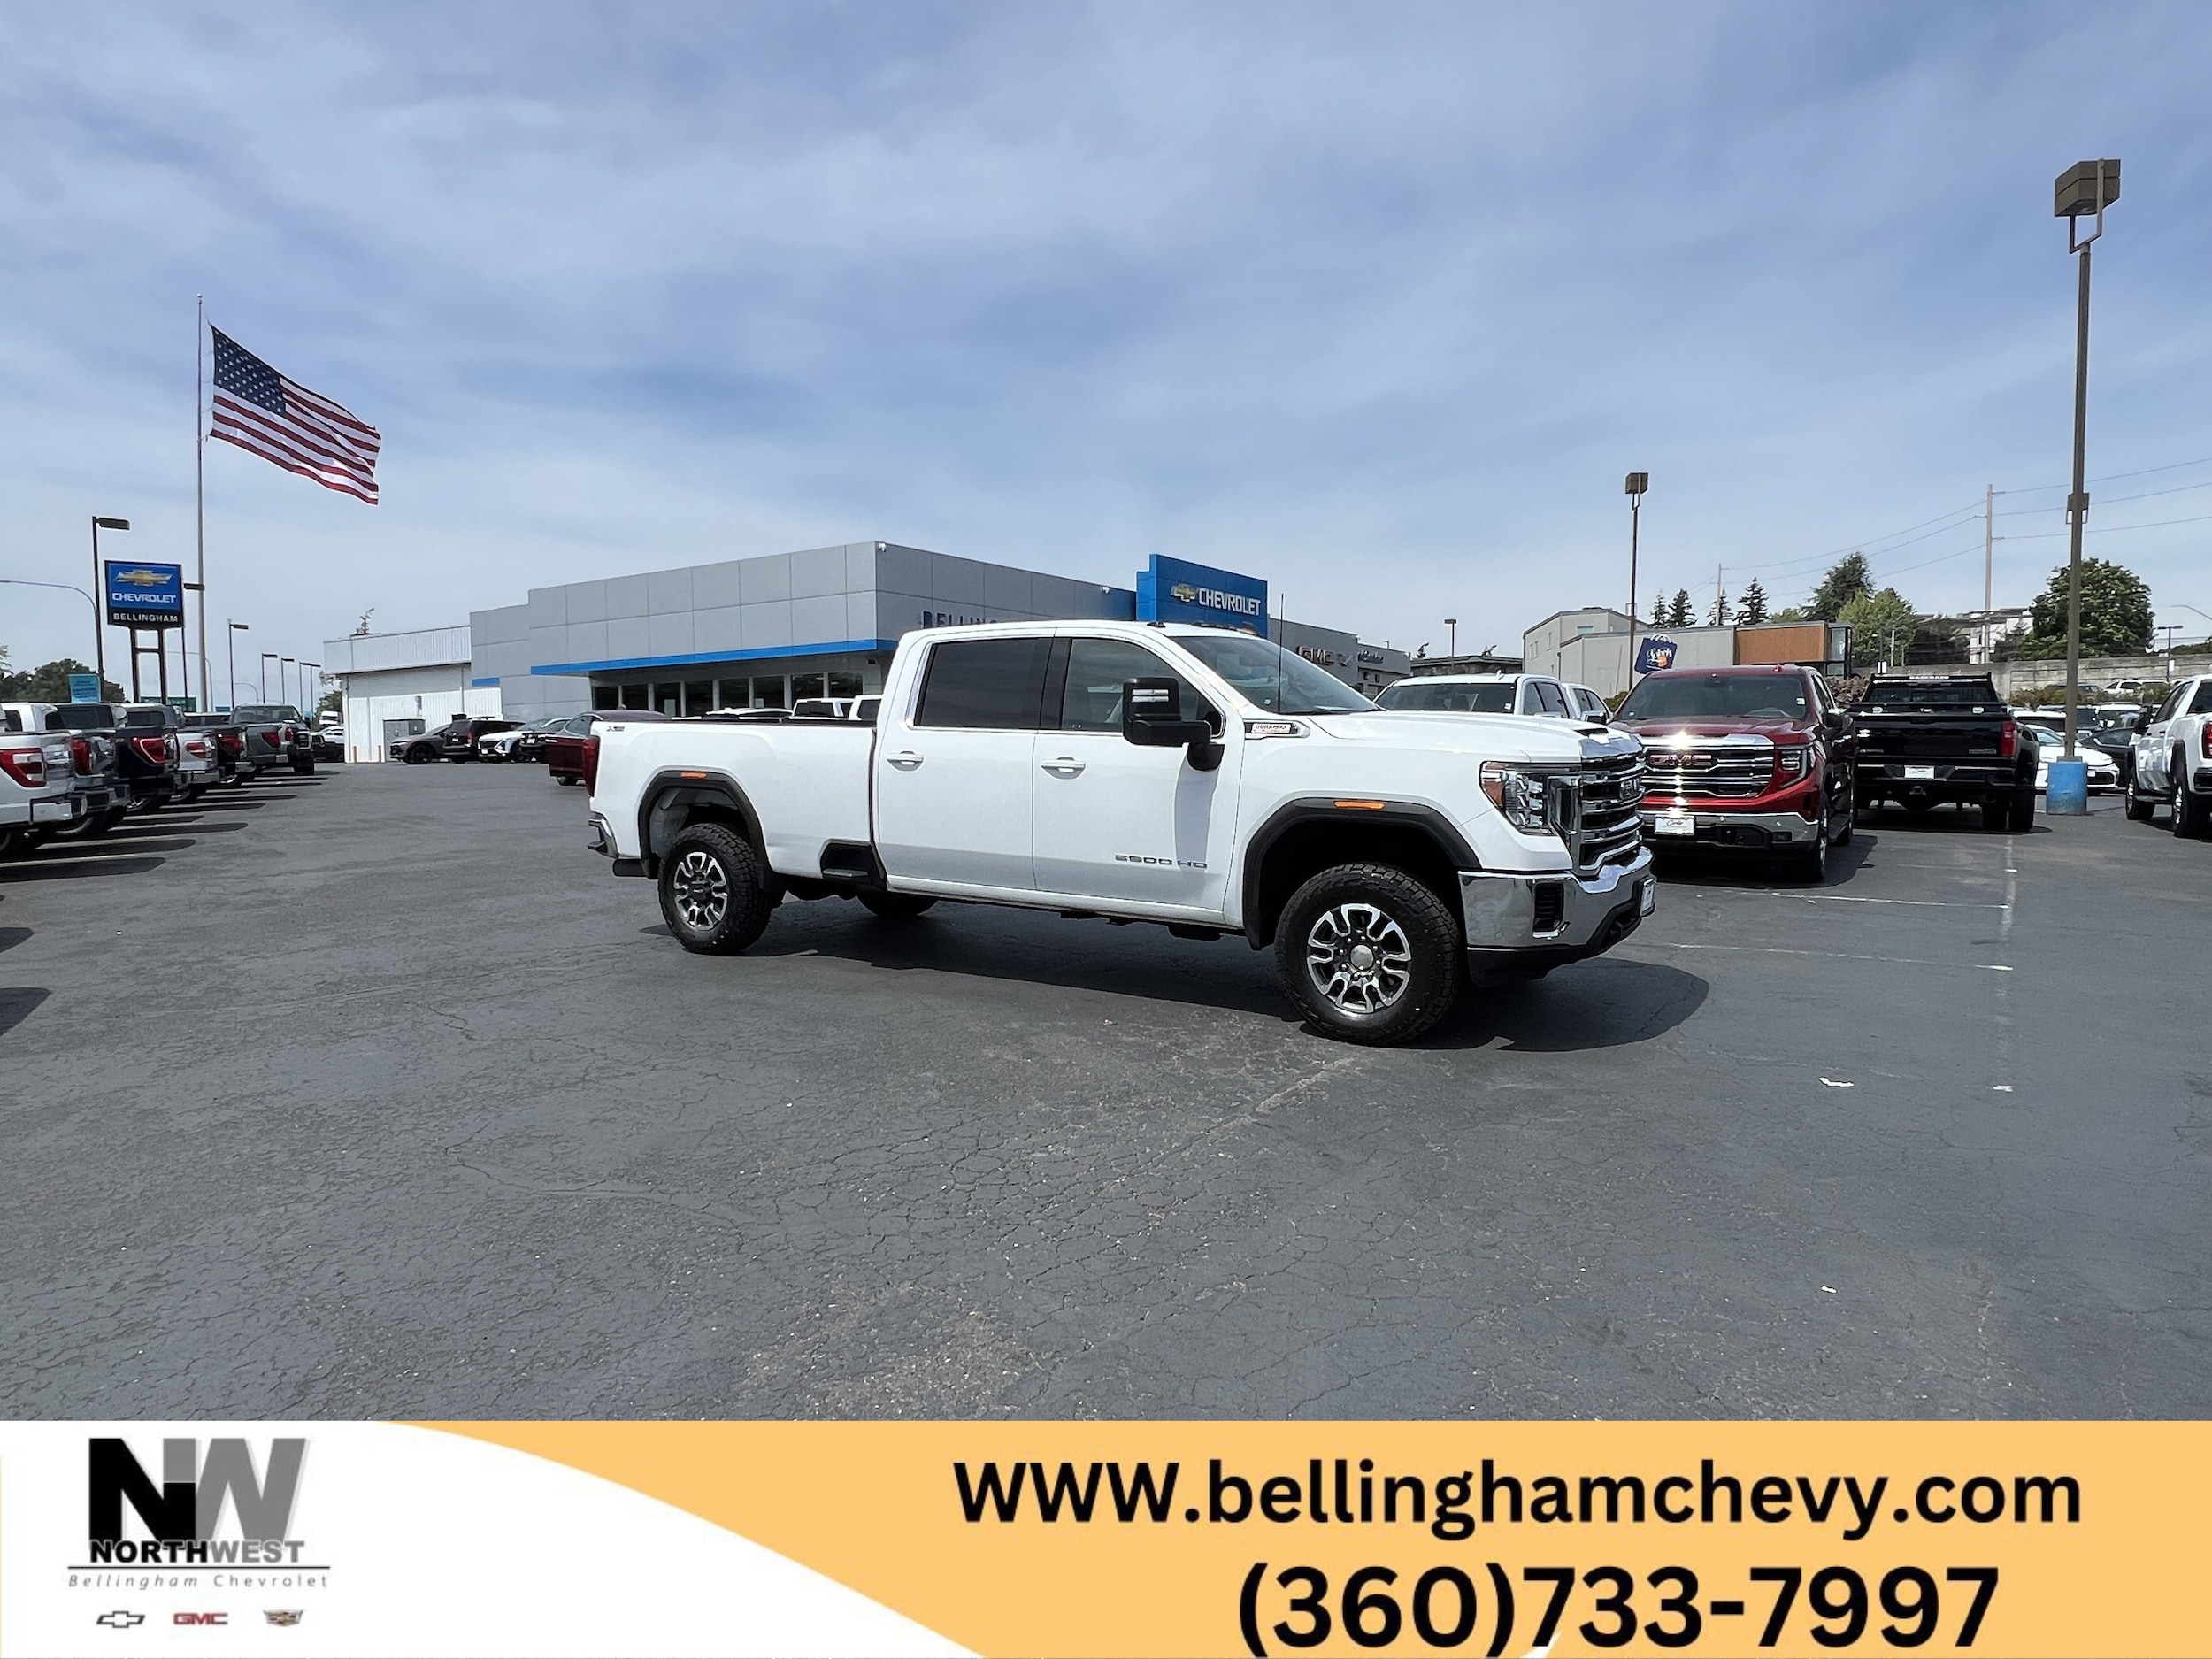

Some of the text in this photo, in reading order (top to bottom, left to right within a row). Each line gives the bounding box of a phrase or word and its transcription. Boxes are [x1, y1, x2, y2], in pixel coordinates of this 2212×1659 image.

[111, 592, 176, 603] CHEVROLET
[1198, 588, 1261, 616] CHEVROLET
[112, 612, 179, 623] BELLINGHAM
[1650, 754, 1712, 766] GMC
[1177, 860, 1207, 869] HD
